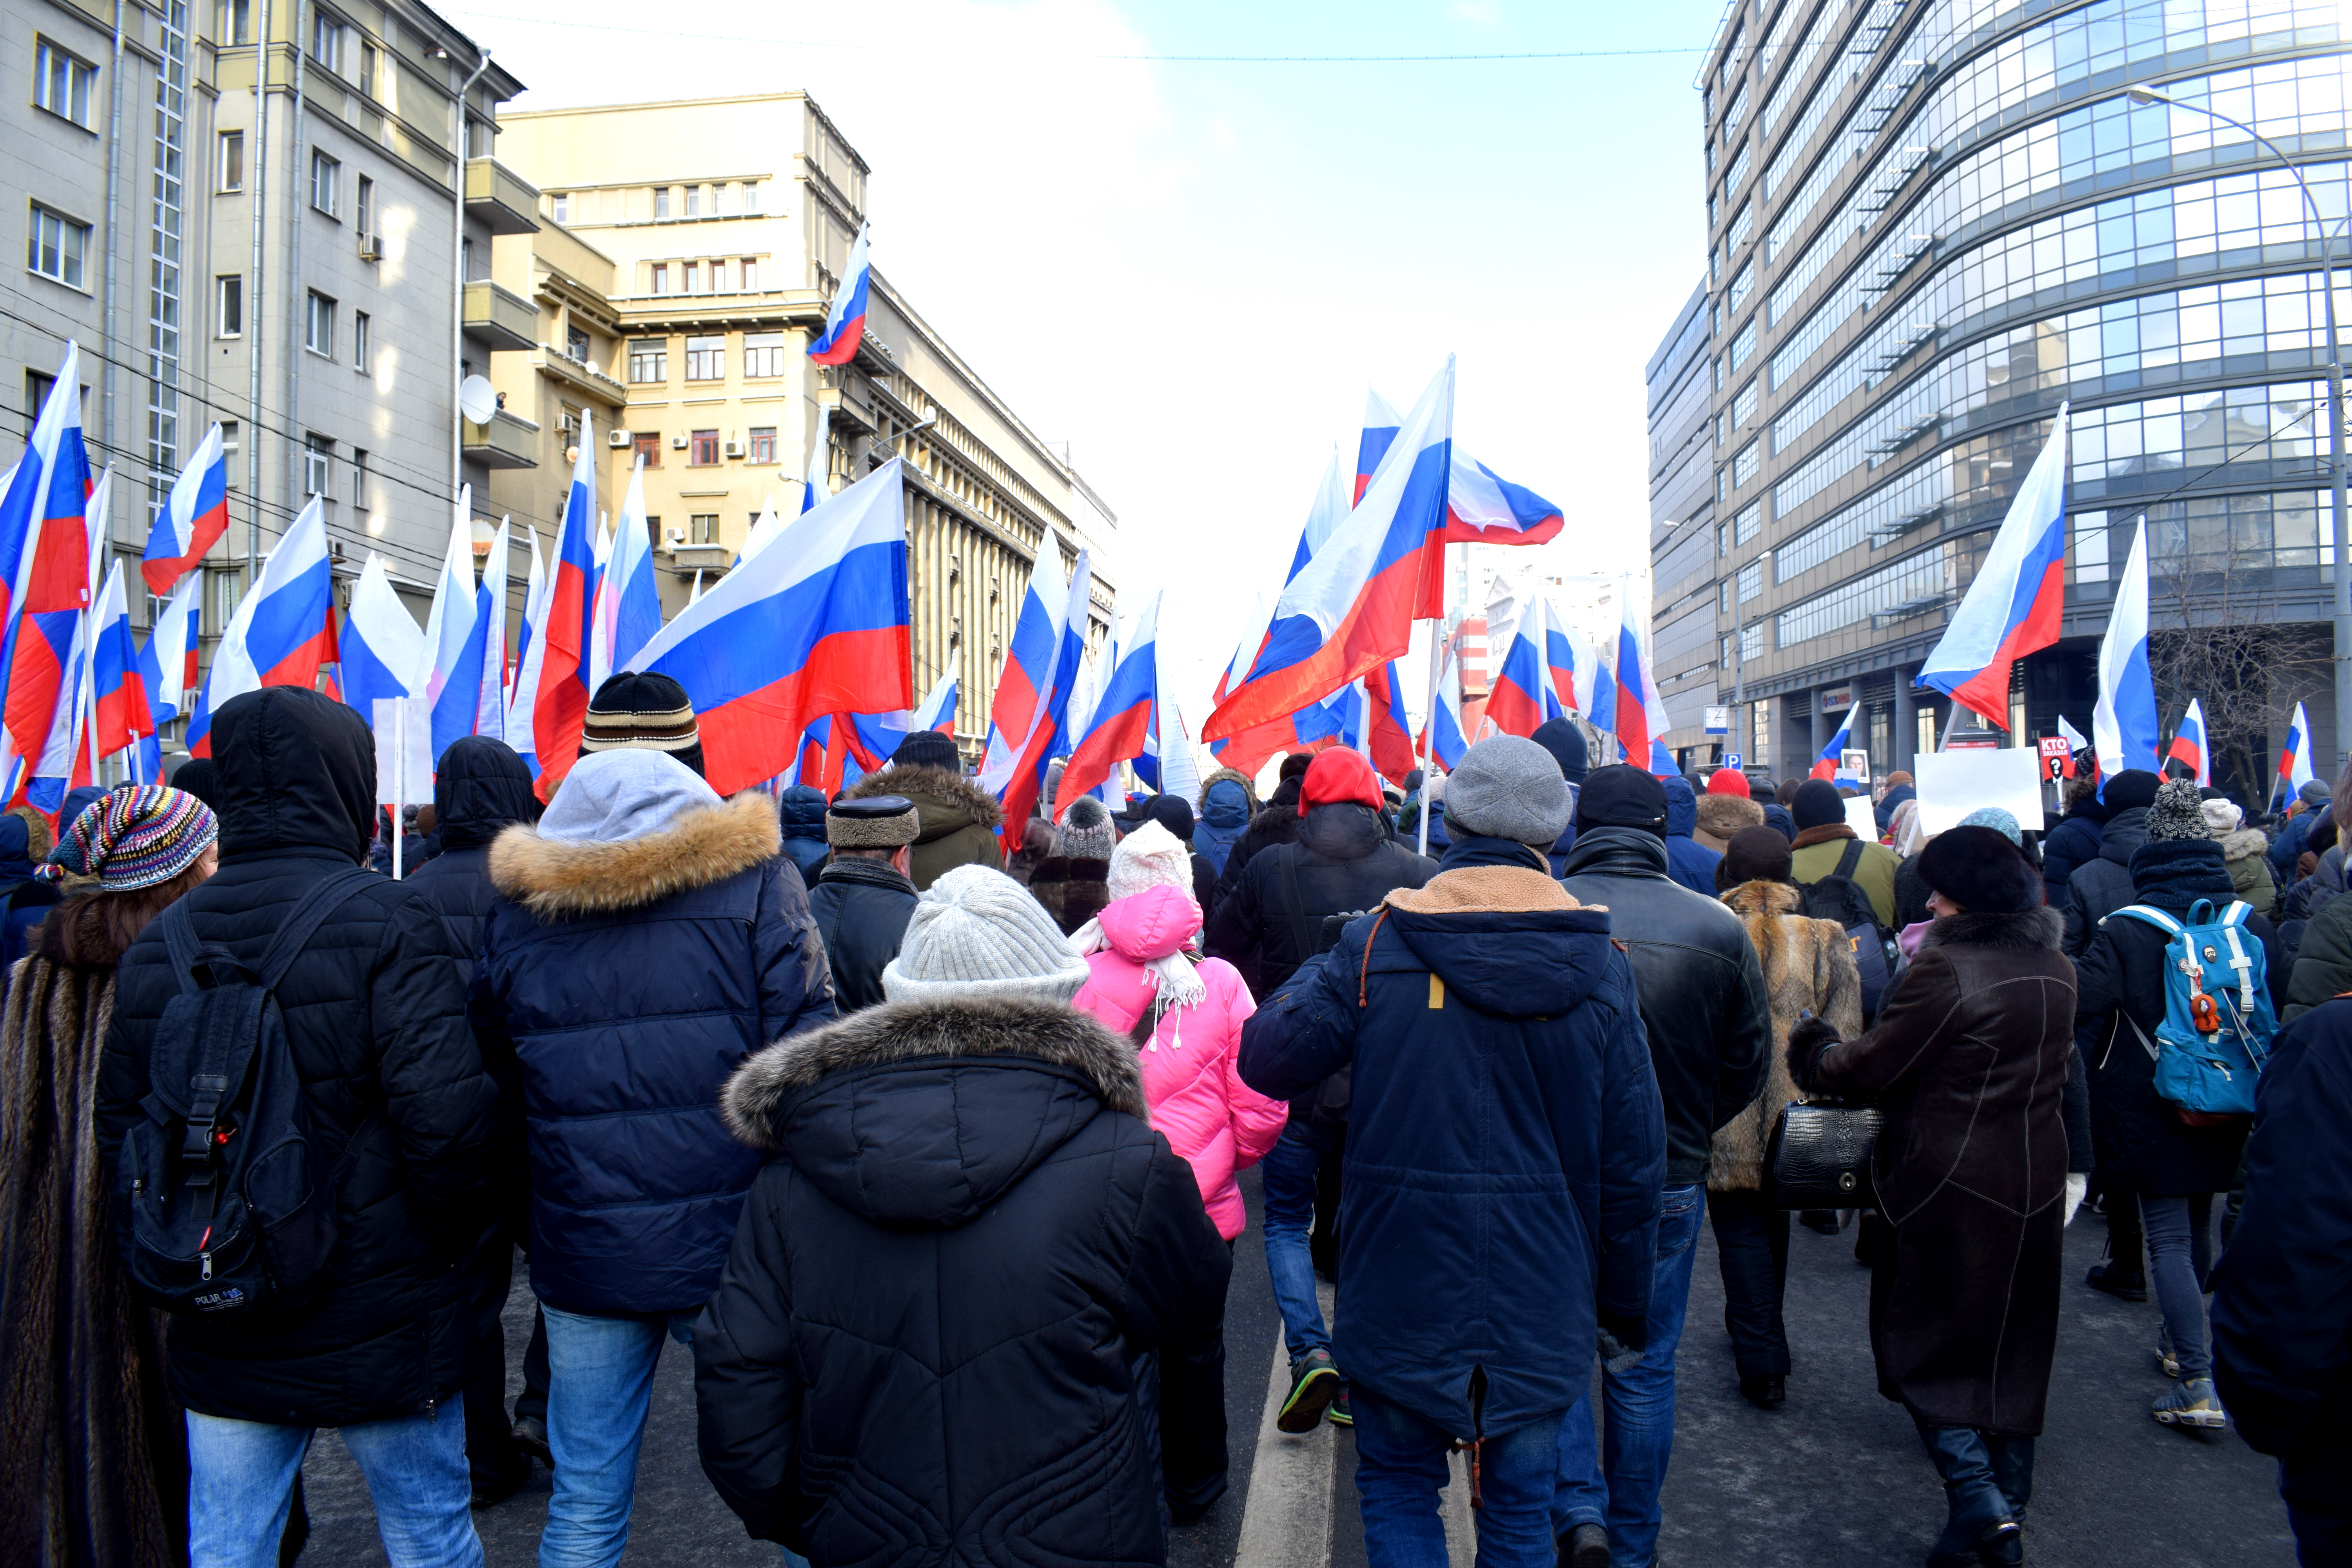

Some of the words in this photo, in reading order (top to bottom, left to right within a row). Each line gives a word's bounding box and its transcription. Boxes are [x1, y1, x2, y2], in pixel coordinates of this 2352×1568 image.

[2041, 738, 2067, 750] КТО
[1729, 755, 1739, 769] P
[2051, 759, 2061, 775] ?
[195, 1294, 222, 1305] POLAR
[216, 1296, 244, 1305] Adventure
